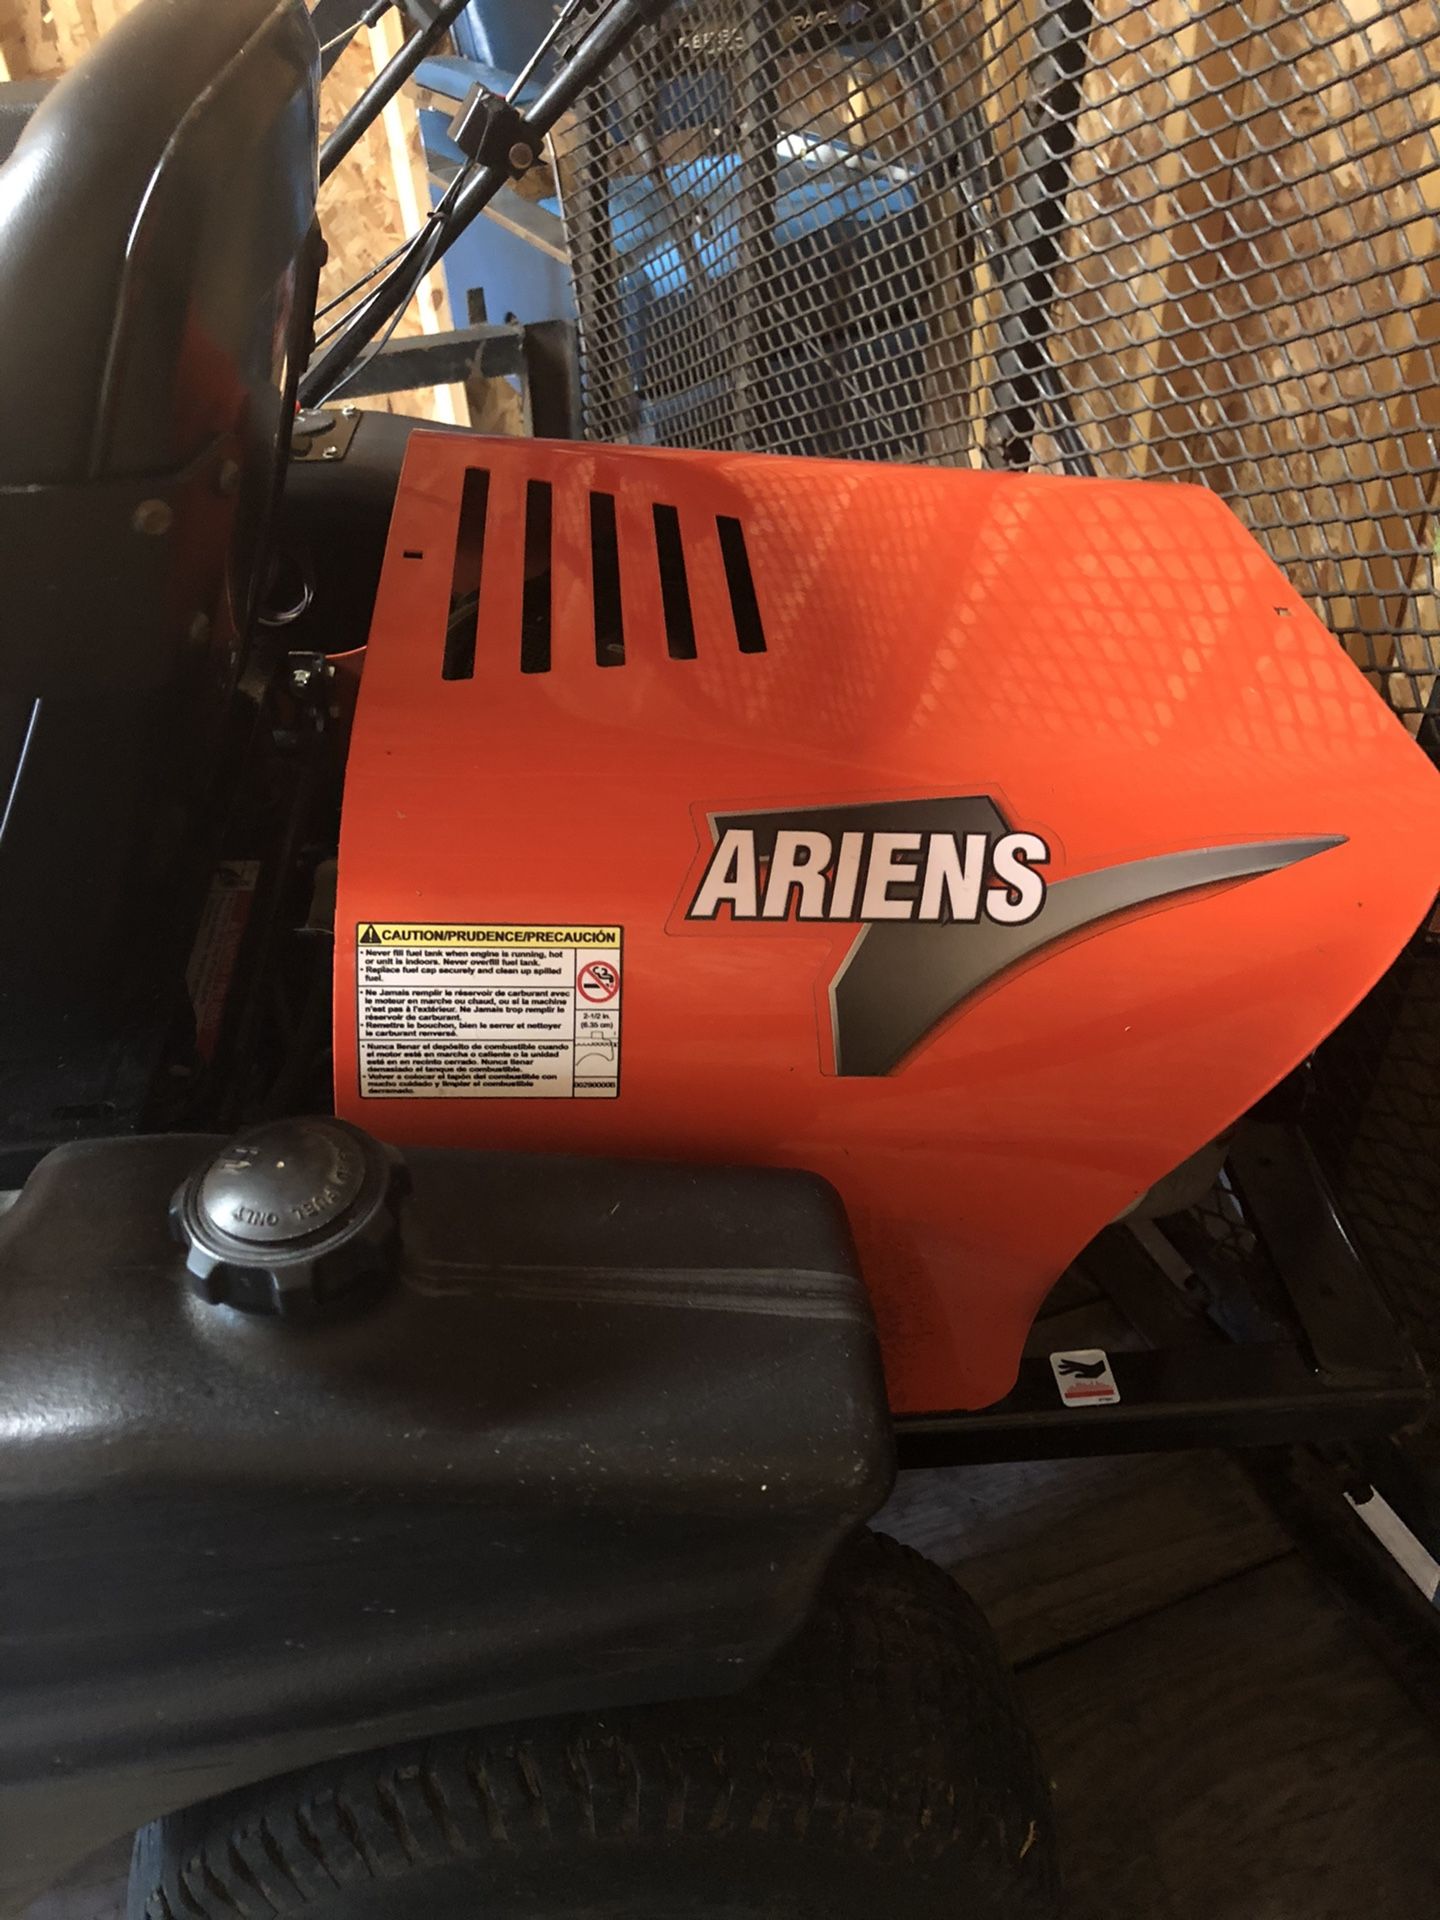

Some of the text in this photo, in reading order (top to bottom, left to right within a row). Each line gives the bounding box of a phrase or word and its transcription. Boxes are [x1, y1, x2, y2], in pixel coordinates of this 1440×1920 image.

[687, 829, 1049, 924] ARIENS
[382, 930, 616, 942] CAUTION/PRUDENCE/PRECAUCIÓN
[439, 967, 475, 975] securely
